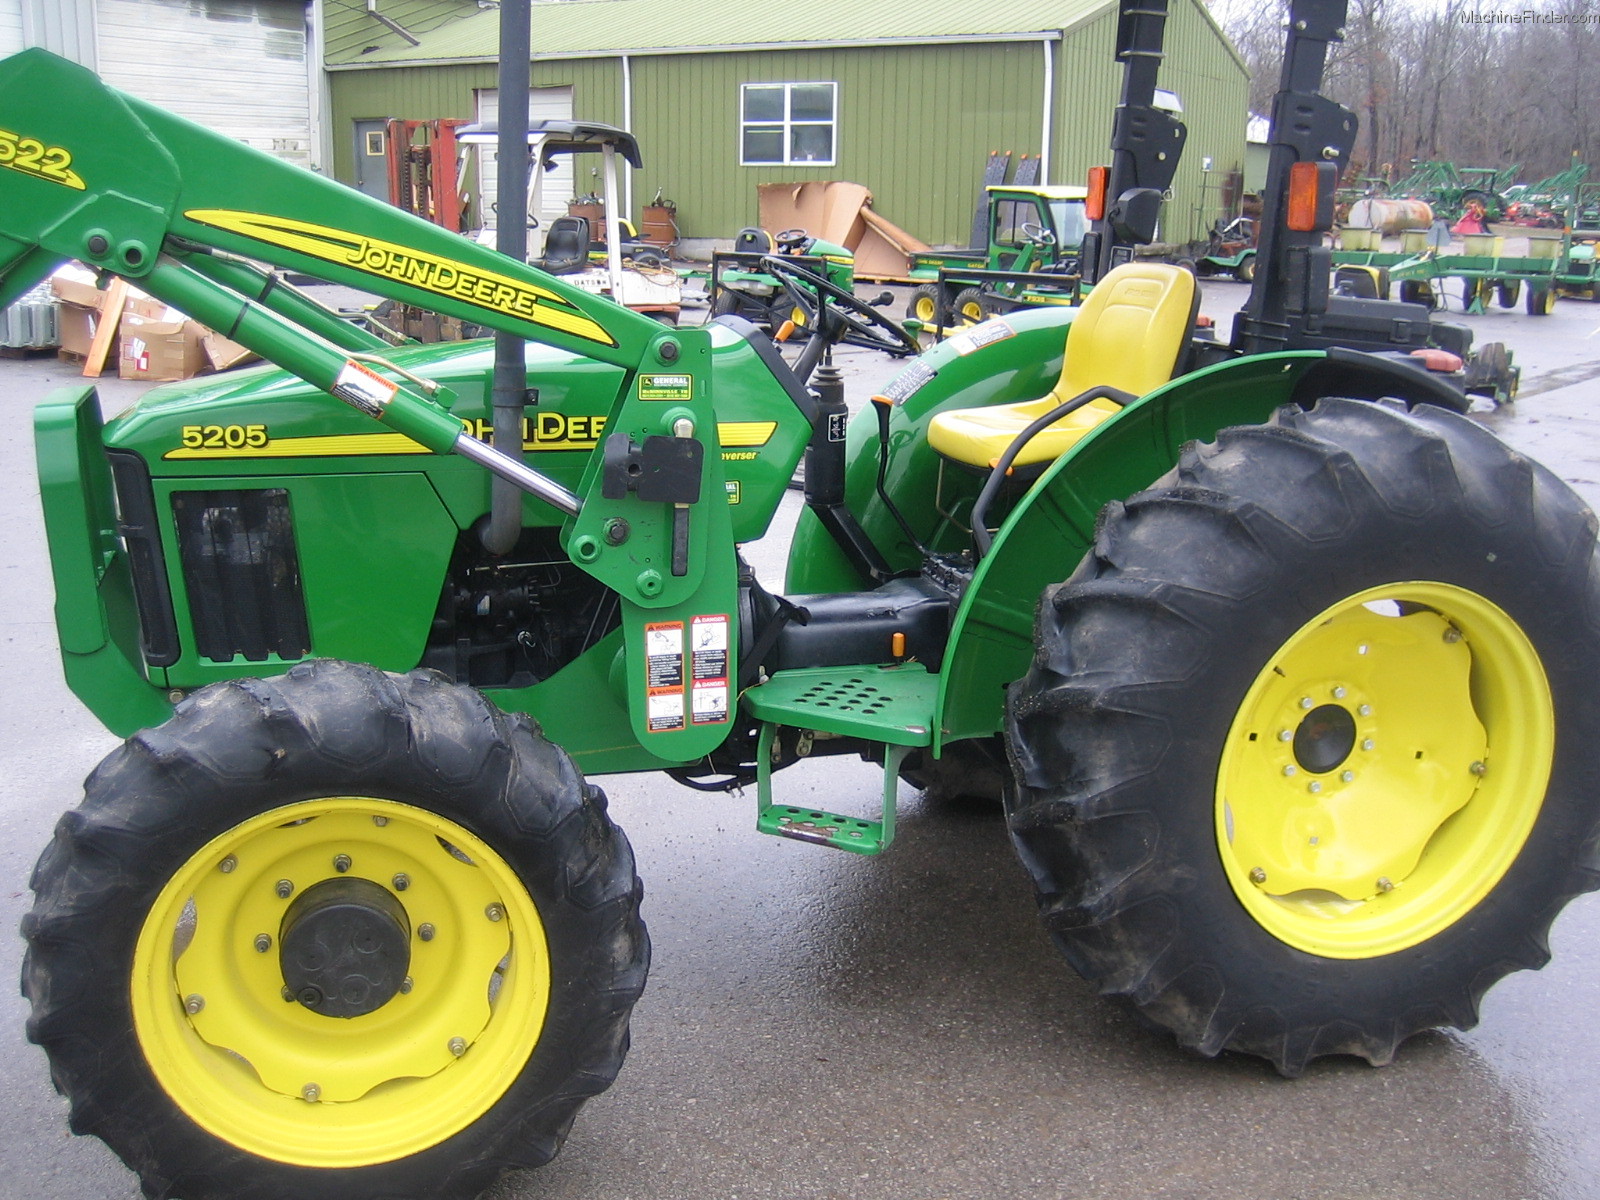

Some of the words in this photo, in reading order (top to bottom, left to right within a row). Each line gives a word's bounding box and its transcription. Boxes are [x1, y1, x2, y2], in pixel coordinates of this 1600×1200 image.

[0, 129, 72, 180] 522
[346, 240, 431, 286] JOHN
[431, 262, 536, 317] DEERE
[182, 425, 268, 448] 5205
[536, 412, 608, 442] DEE
